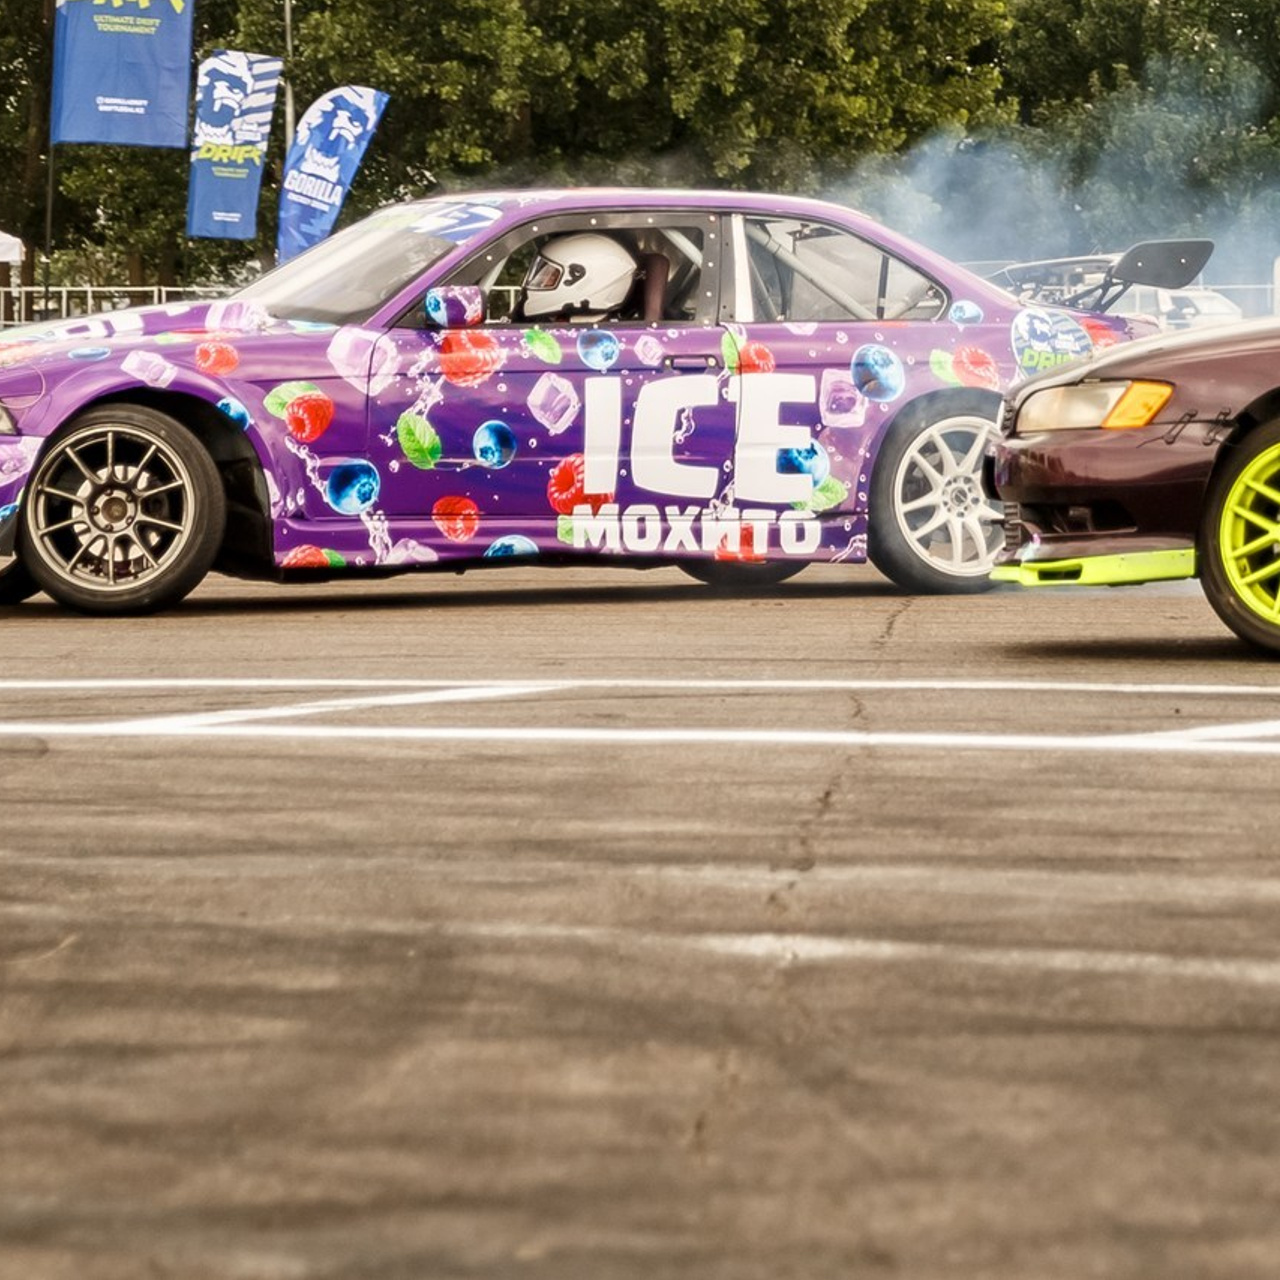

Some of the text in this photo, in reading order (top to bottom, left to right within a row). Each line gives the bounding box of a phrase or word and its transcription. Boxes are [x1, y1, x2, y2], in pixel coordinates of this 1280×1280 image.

[197, 141, 262, 166] DRIFT
[283, 169, 344, 207] GORILLA
[583, 373, 817, 504] ICE
[571, 503, 822, 555] МОХИТО
